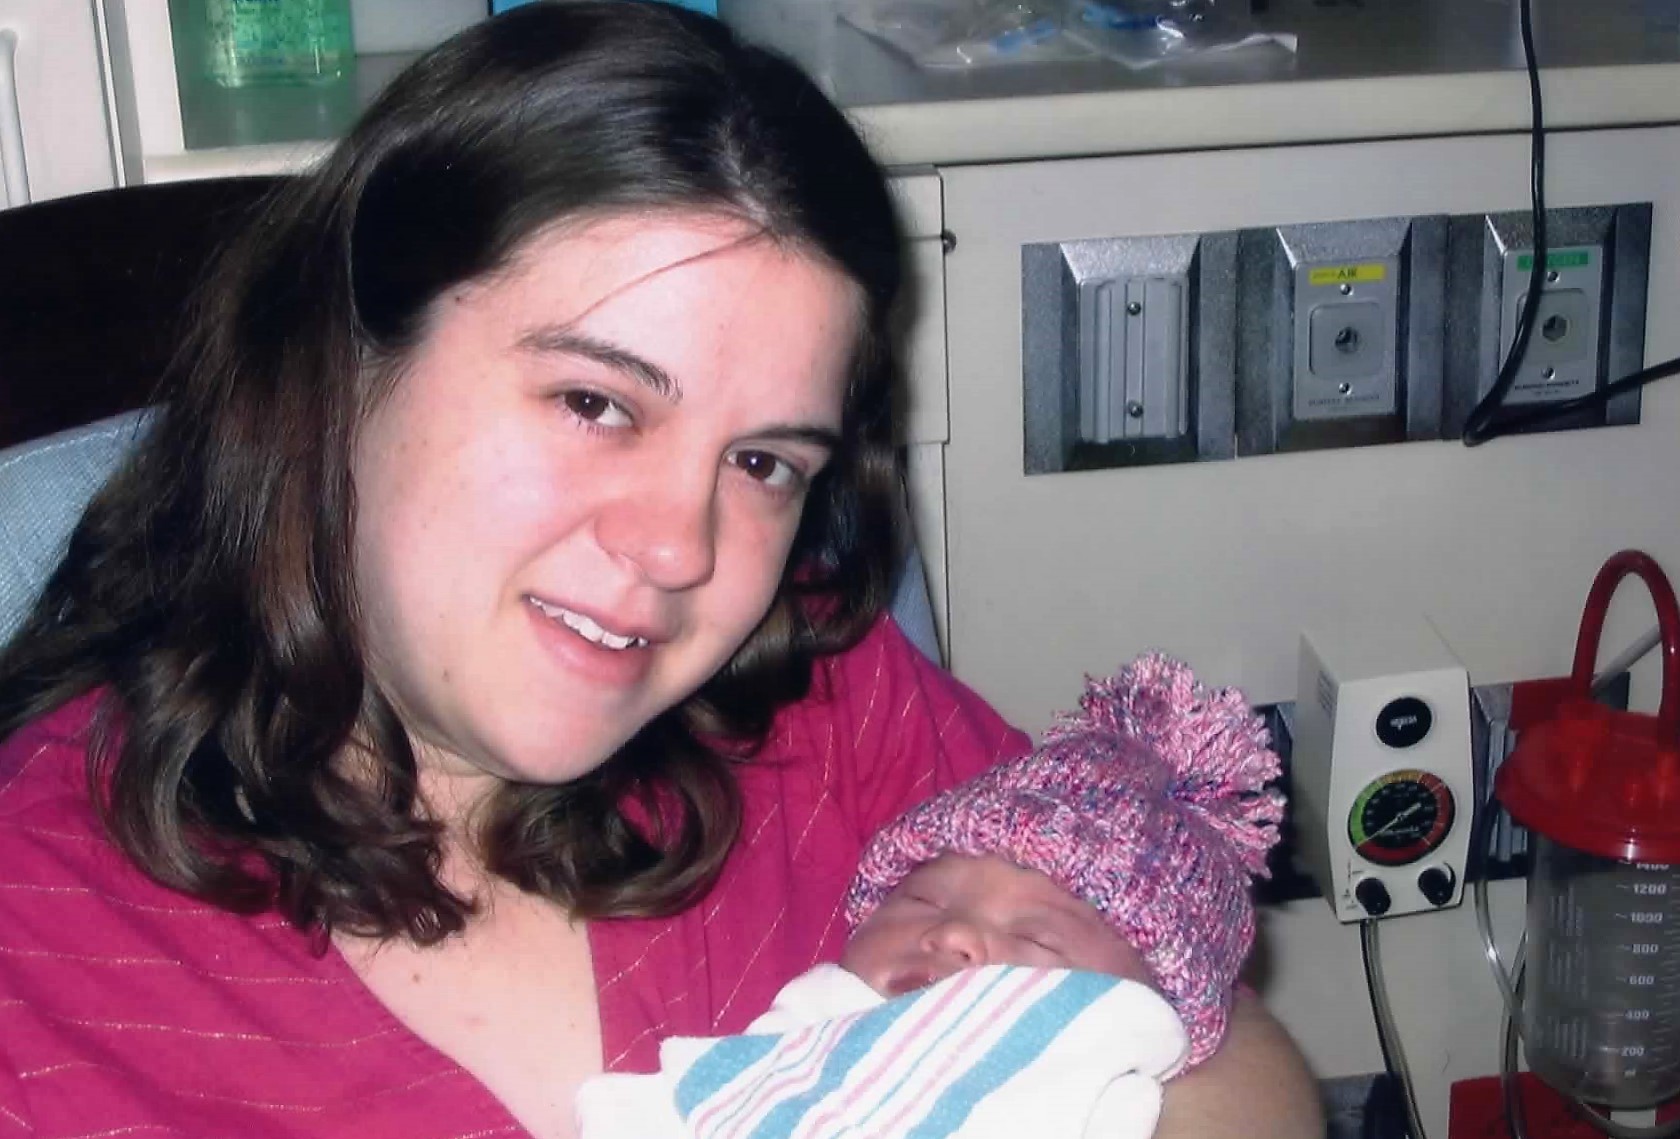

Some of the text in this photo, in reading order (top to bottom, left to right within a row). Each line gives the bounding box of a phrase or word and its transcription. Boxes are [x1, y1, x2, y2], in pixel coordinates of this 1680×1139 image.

[1337, 268, 1358, 280] AIR
[1634, 883, 1667, 895] 1200
[1631, 912, 1663, 924] 1000
[1632, 944, 1659, 953] 800
[1629, 975, 1655, 985] 600
[1625, 1010, 1650, 1020] 400
[1622, 1046, 1646, 1056] 200
